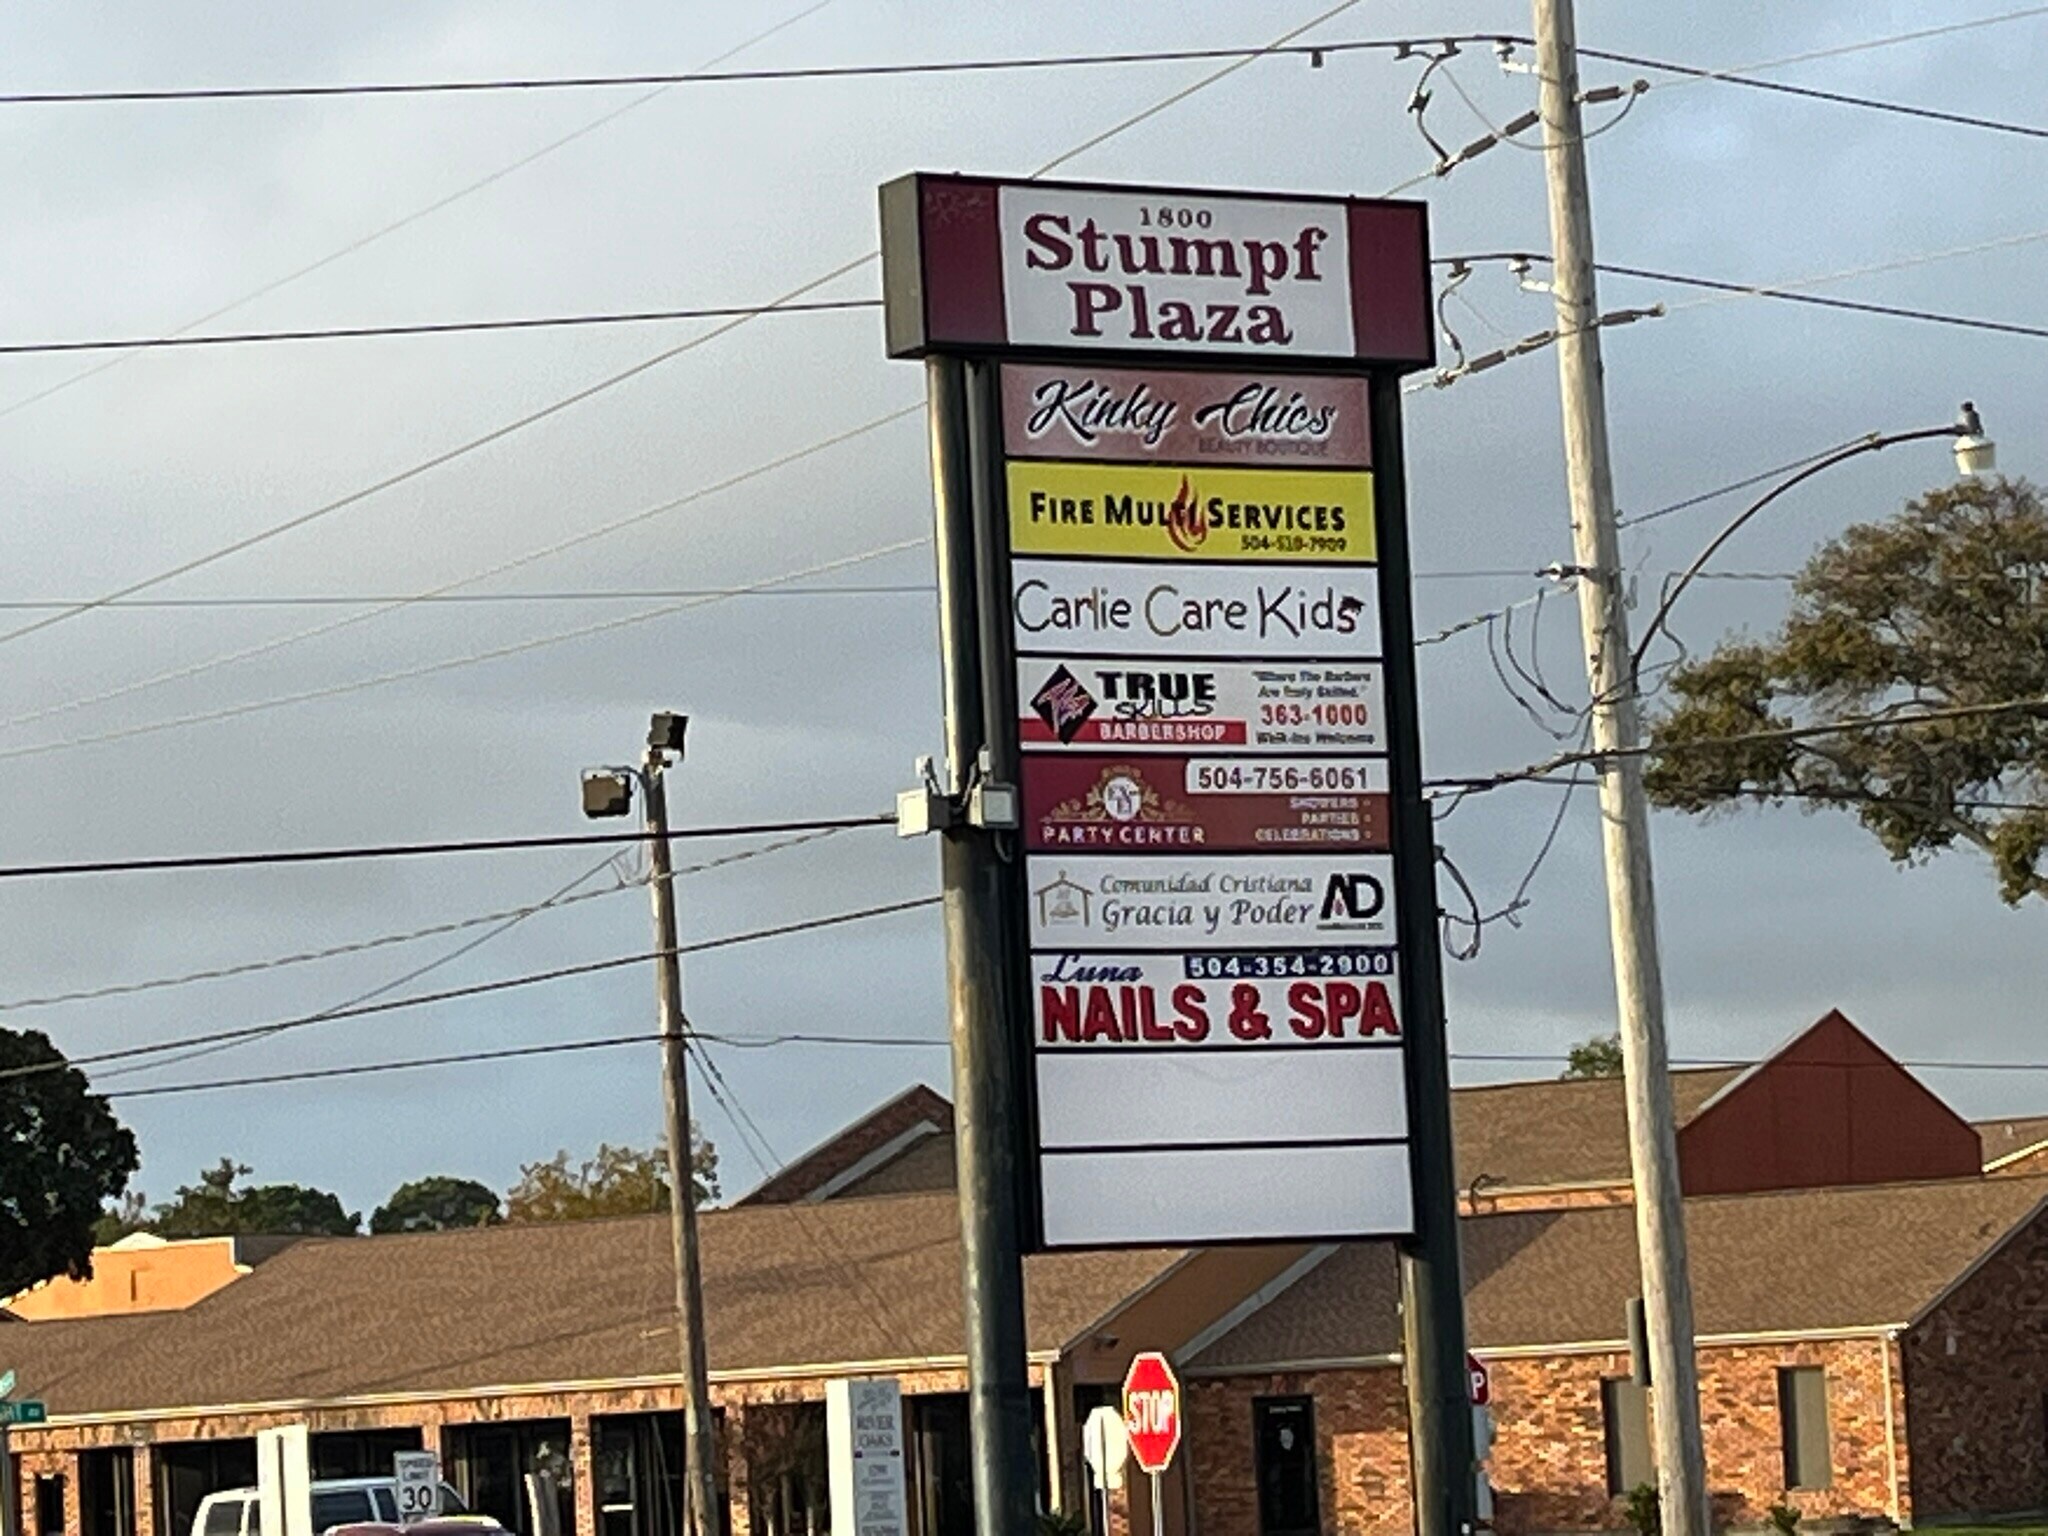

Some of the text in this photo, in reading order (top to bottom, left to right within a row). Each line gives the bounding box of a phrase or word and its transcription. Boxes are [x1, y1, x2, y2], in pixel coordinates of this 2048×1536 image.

[1140, 207, 1213, 228] 1800
[1023, 213, 1328, 296] Stumpf
[1066, 281, 1293, 345] Plaza
[1027, 379, 1337, 446] Kinky Chics
[1208, 497, 1346, 532] SERVICES
[1014, 579, 1365, 638] Carlie Care Kids
[1095, 671, 1217, 701] TRUE
[1261, 704, 1367, 726] 363-1000
[1100, 722, 1226, 741] BARBERSHOP
[1199, 767, 1367, 789] 504-756-6061
[1042, 827, 1205, 844] PARTY CENTER
[1100, 873, 1312, 894] Comunidad Cristiana
[1102, 895, 1315, 934] Gracia y Poder
[1041, 953, 1143, 983] Luna
[1041, 981, 1401, 1042] NAILS & SPA
[1127, 1391, 1174, 1434] STOP
[403, 1486, 432, 1510] 30
